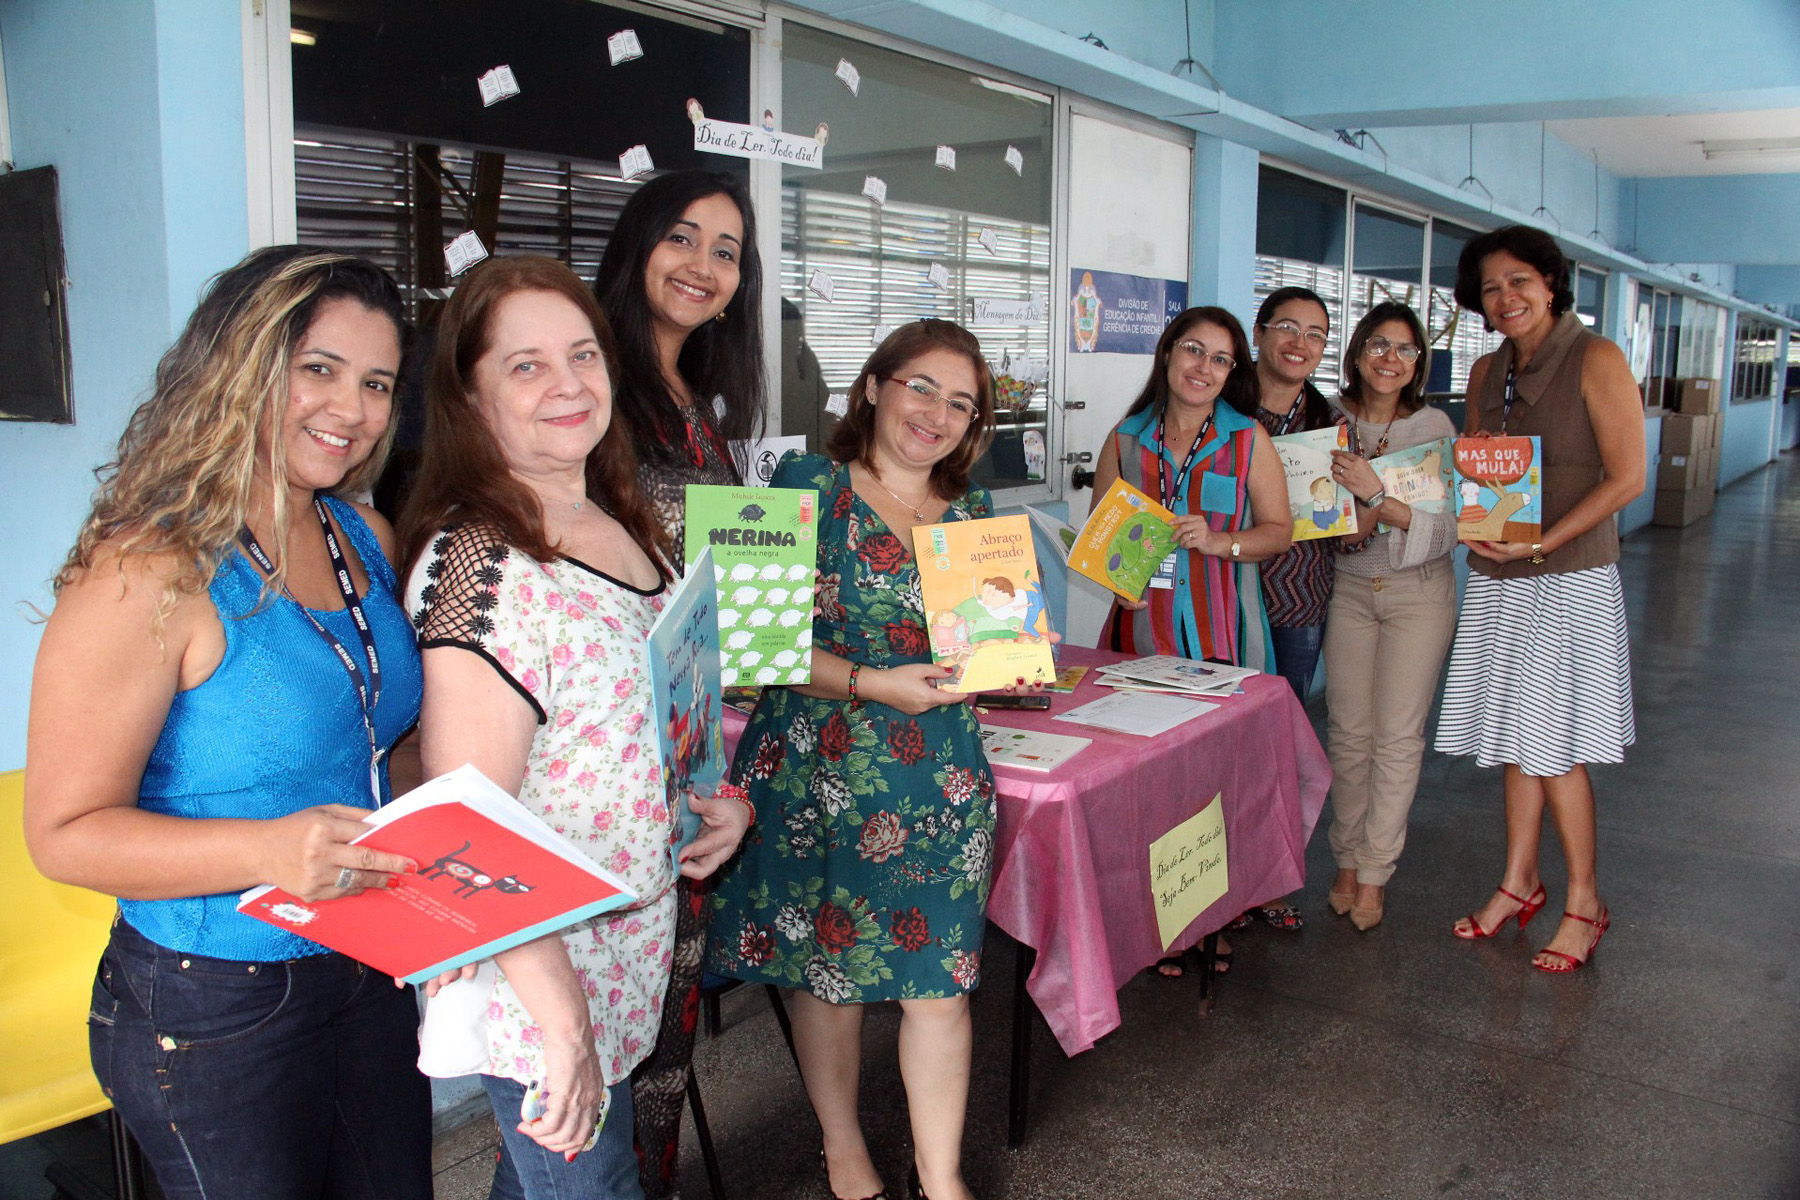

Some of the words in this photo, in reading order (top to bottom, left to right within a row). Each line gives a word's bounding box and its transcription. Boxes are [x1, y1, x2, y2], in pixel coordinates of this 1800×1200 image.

[697, 123, 721, 145] Dia
[724, 134, 736, 148] de
[739, 131, 766, 152] Ler.
[770, 138, 792, 158] Todo
[795, 146, 818, 162] dia!
[974, 301, 1014, 324] Mensagem
[1119, 298, 1140, 310] DIVISÃO
[1141, 301, 1148, 310] DE
[1168, 301, 1181, 312] SALA
[1105, 310, 1135, 323] EDUCAÇÃO
[1103, 322, 1132, 333] GERÊNCIA
[1132, 324, 1140, 334] DE
[1140, 325, 1161, 335] CRECHE
[1458, 449, 1488, 462] MAS
[1495, 449, 1520, 460] QUE
[1476, 460, 1524, 475] MULA!
[326, 533, 340, 560] SEMED
[708, 528, 796, 546] NERINA
[980, 533, 1022, 545] Abraço
[250, 542, 271, 570] SEMED
[970, 546, 1024, 563] apertado
[338, 569, 353, 595] SEMED
[352, 606, 368, 631] SEMED
[334, 643, 356, 671] SEMED
[367, 645, 379, 674] SEMED
[667, 646, 682, 672] Tem
[1156, 859, 1169, 881] Dia
[1170, 855, 1177, 869] de
[1196, 834, 1212, 851] Todo
[1159, 887, 1177, 908] Seja
